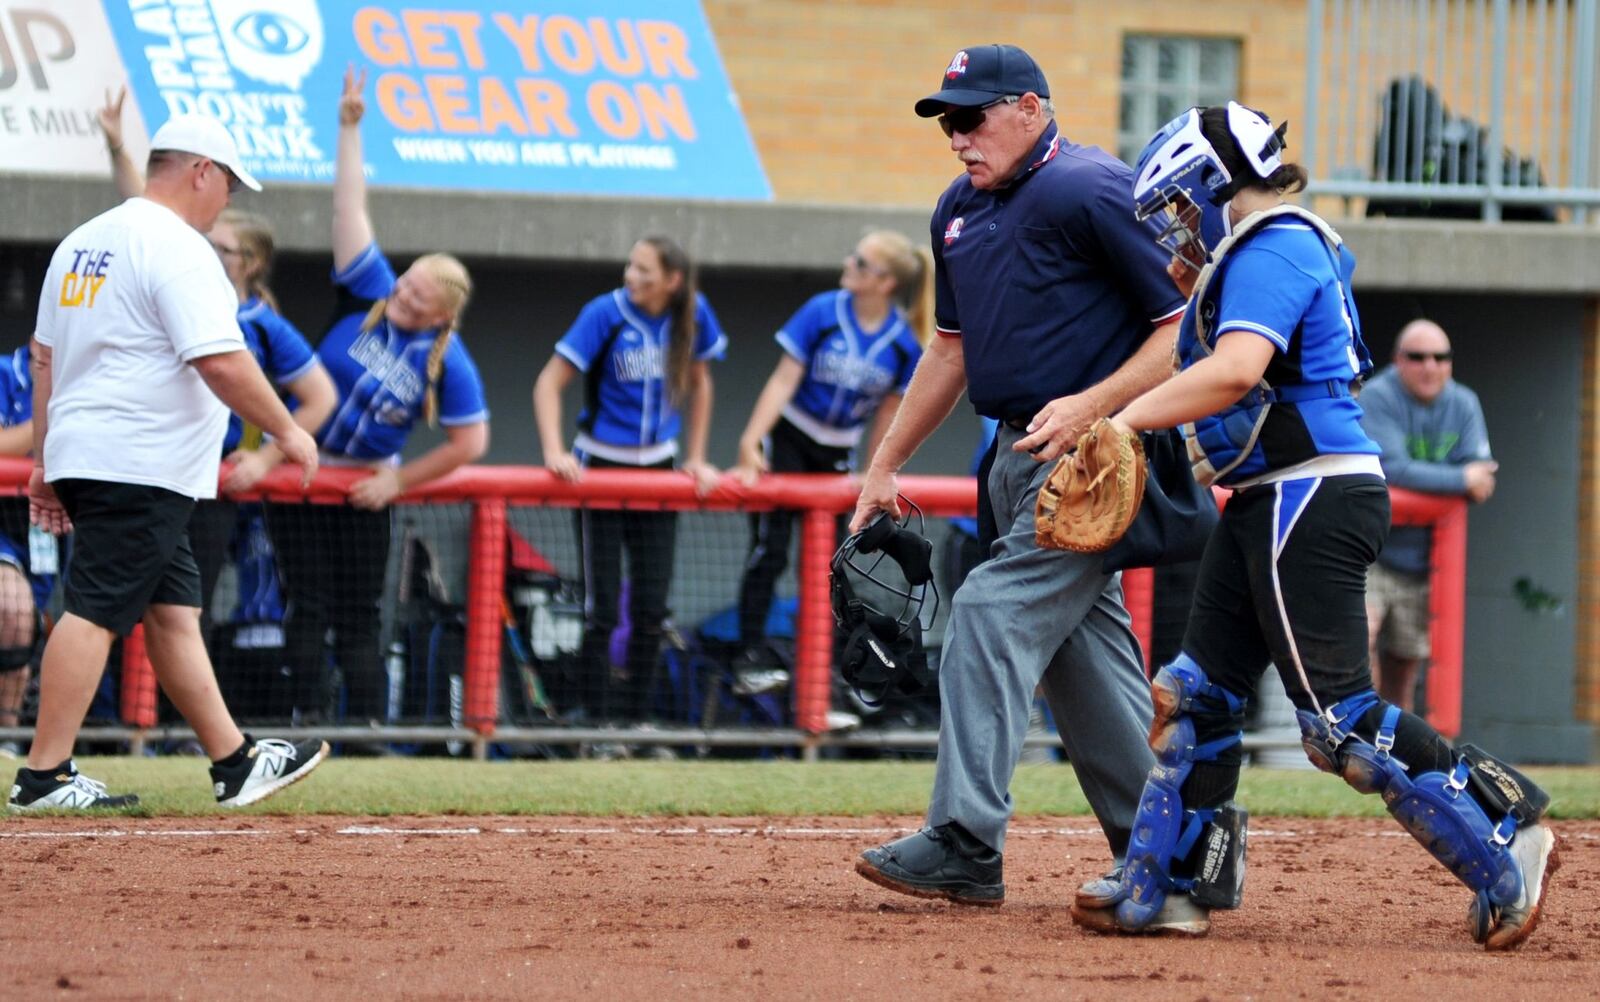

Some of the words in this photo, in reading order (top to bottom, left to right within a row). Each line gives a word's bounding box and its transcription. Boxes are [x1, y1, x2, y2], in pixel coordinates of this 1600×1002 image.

[172, 0, 235, 89] HAR
[353, 8, 486, 69] GET
[492, 13, 697, 78] YOUR
[28, 106, 100, 136] MILK
[160, 90, 306, 126] DON'T
[376, 72, 579, 137] GEAR
[586, 80, 697, 141] ON
[232, 125, 322, 159] INK
[393, 138, 467, 164] WHEN
[468, 139, 516, 165] YOU
[521, 141, 568, 167] ARE
[570, 143, 676, 170] PLAYING!
[73, 249, 114, 277] THE
[1202, 850, 1219, 881] SAVER
